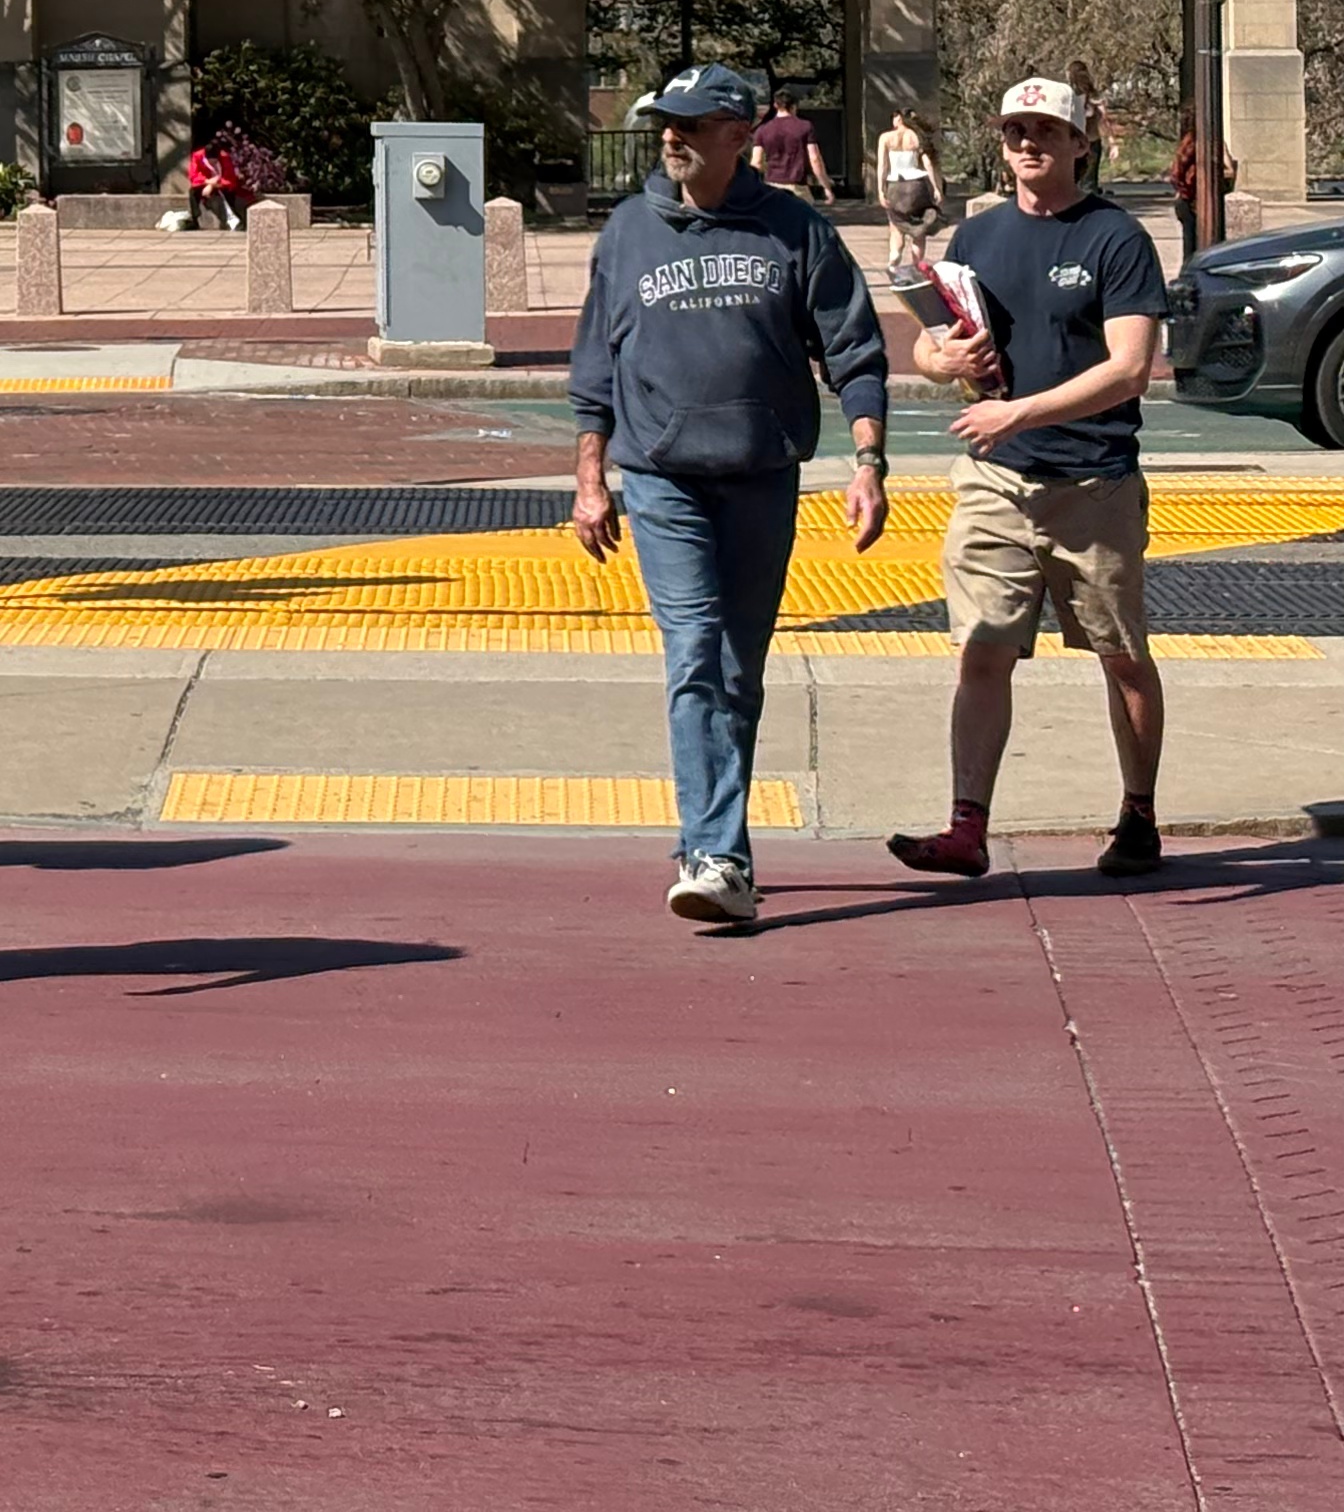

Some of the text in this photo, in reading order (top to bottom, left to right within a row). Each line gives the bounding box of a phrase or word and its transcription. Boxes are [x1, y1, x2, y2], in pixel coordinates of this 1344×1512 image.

[639, 254, 783, 307] SAN DIEGO
[669, 293, 761, 311] CALIFORNIA
